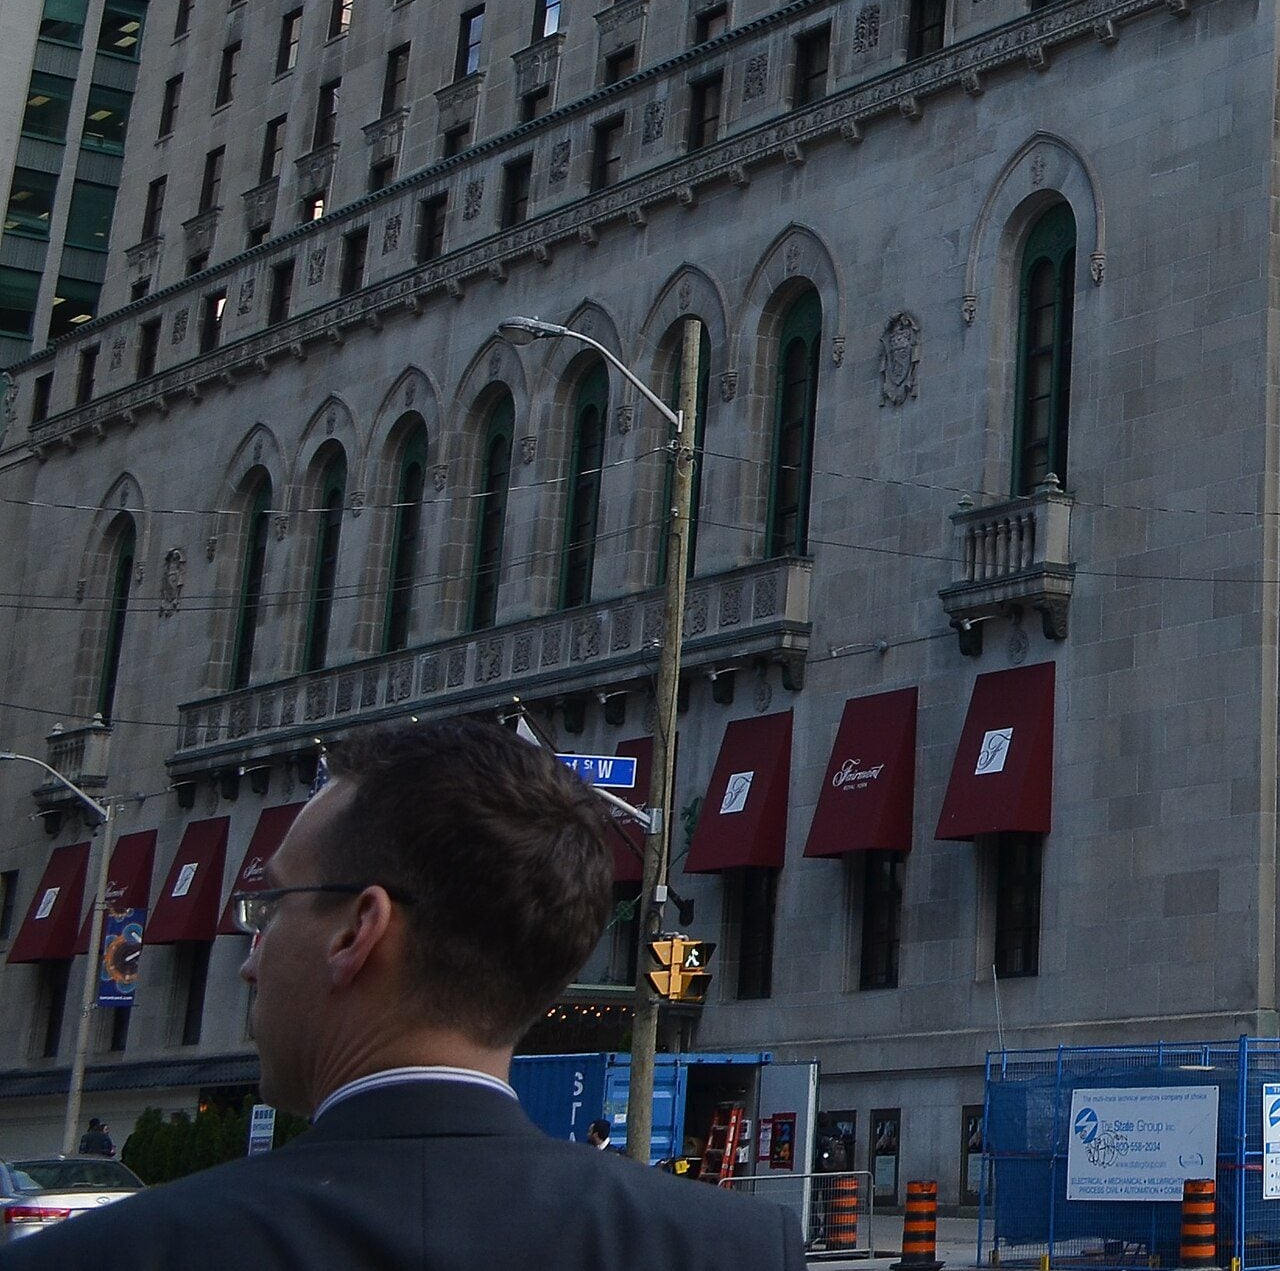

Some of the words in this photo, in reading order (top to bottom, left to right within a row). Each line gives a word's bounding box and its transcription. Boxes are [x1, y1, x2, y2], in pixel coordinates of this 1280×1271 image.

[584, 759, 594, 770] St
[598, 760, 613, 779] W
[833, 758, 884, 786] Fairmont
[1101, 1121, 1113, 1132] The
[1114, 1121, 1134, 1132] State
[1137, 1120, 1163, 1134] Group
